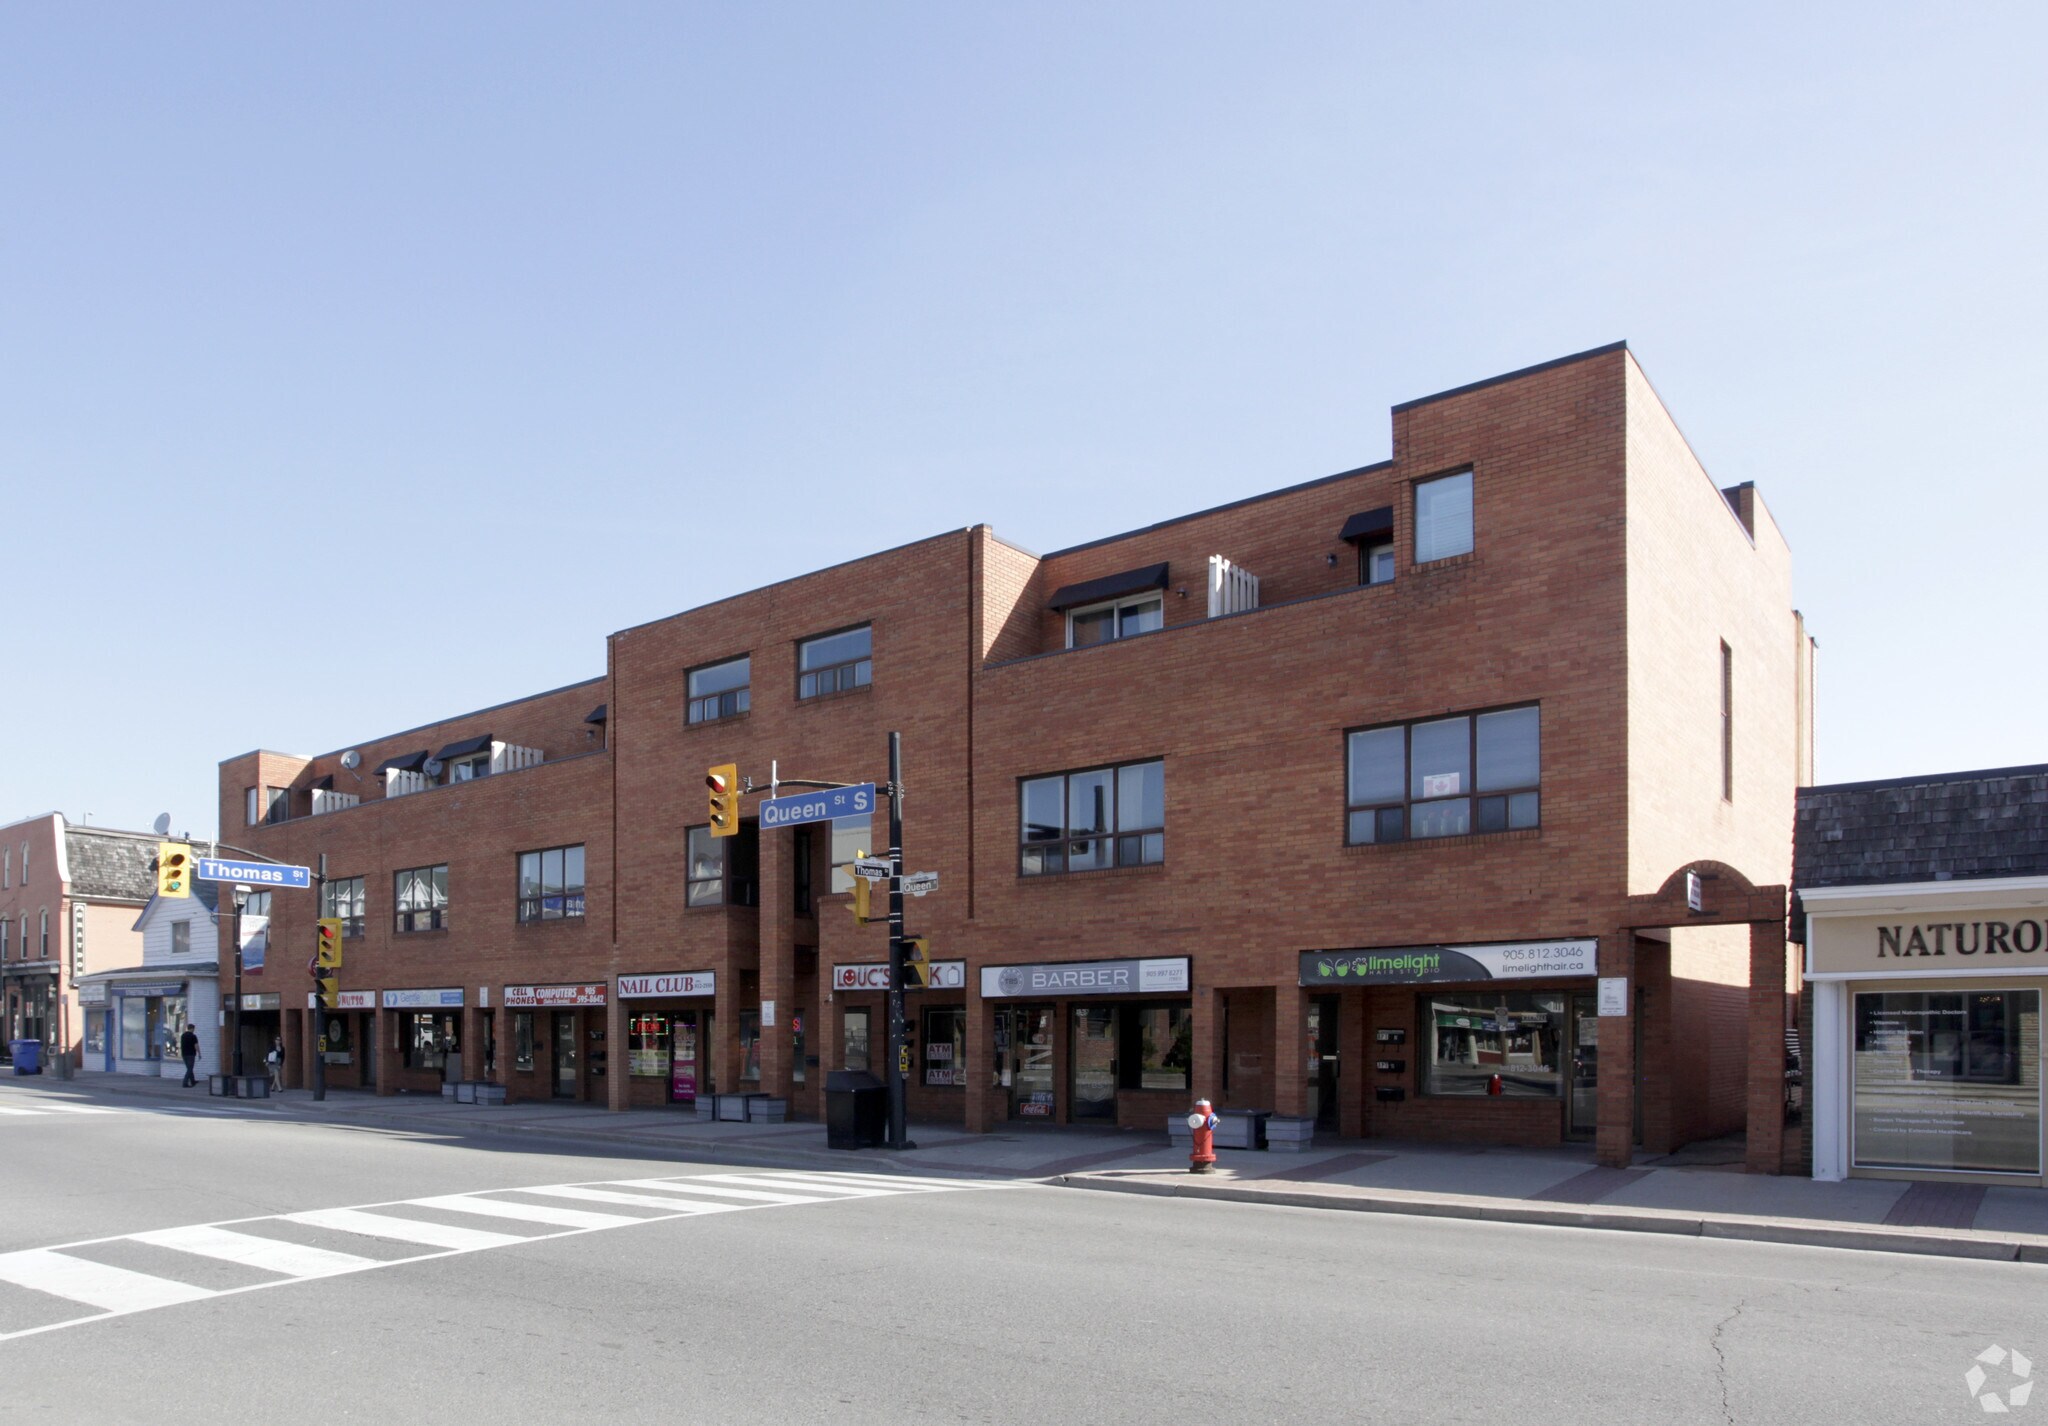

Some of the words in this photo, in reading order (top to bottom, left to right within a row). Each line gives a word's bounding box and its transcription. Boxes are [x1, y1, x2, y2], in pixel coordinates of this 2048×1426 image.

[764, 801, 826, 823] Queen
[834, 795, 845, 805] St
[854, 791, 868, 810] S
[205, 862, 283, 881] Thomas
[292, 870, 304, 878] St
[856, 866, 883, 877] Thomas
[904, 882, 932, 892] Queen
[1877, 919, 2048, 957] NATURO
[1503, 947, 1584, 960] 905.812.3046
[1369, 953, 1440, 977] limelight
[1502, 962, 1584, 973] limelighthair.ca
[1400, 967, 1440, 975] STUDIO
[1032, 970, 1129, 988] BARBER
[584, 986, 596, 995] 905
[619, 978, 652, 994] NAIL
[656, 976, 694, 993] CLUB
[512, 987, 528, 996] CELL
[536, 988, 577, 999] COMPUTERS
[505, 996, 535, 1005] PHONES
[929, 1045, 951, 1053] ATM
[1510, 1064, 1550, 1072] 812-3046
[929, 1070, 951, 1078] ATM
